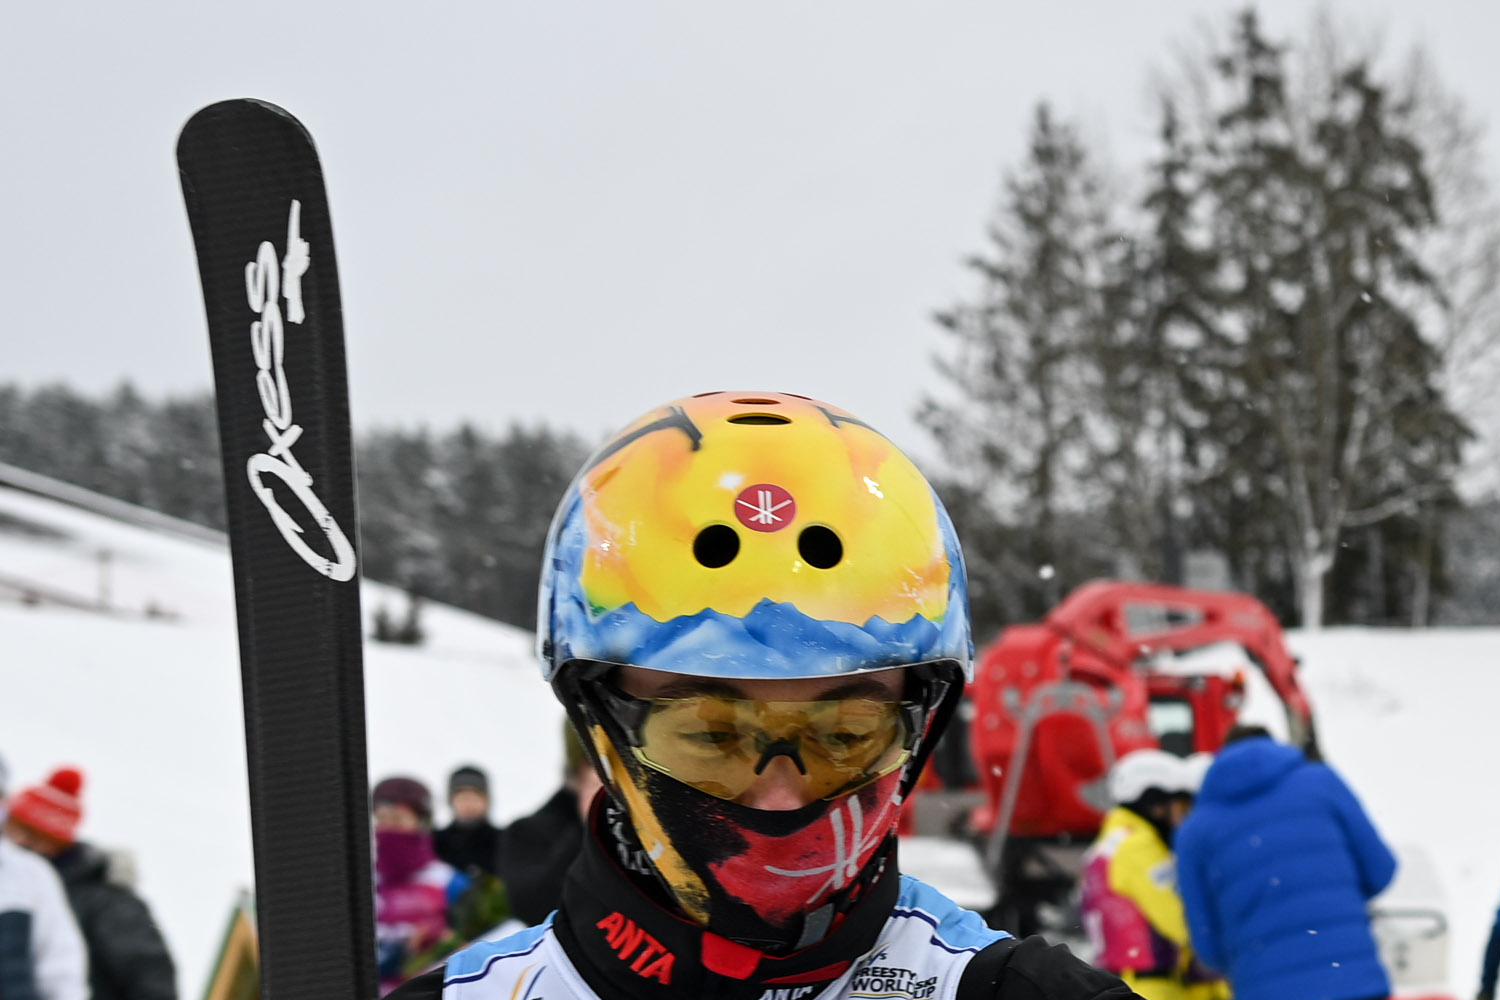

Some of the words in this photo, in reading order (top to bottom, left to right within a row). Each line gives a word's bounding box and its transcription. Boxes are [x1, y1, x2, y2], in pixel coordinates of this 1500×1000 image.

[245, 240, 356, 582] Oxess
[596, 912, 676, 985] ANTA
[914, 985, 937, 999] UP
[915, 976, 938, 989] SKI
